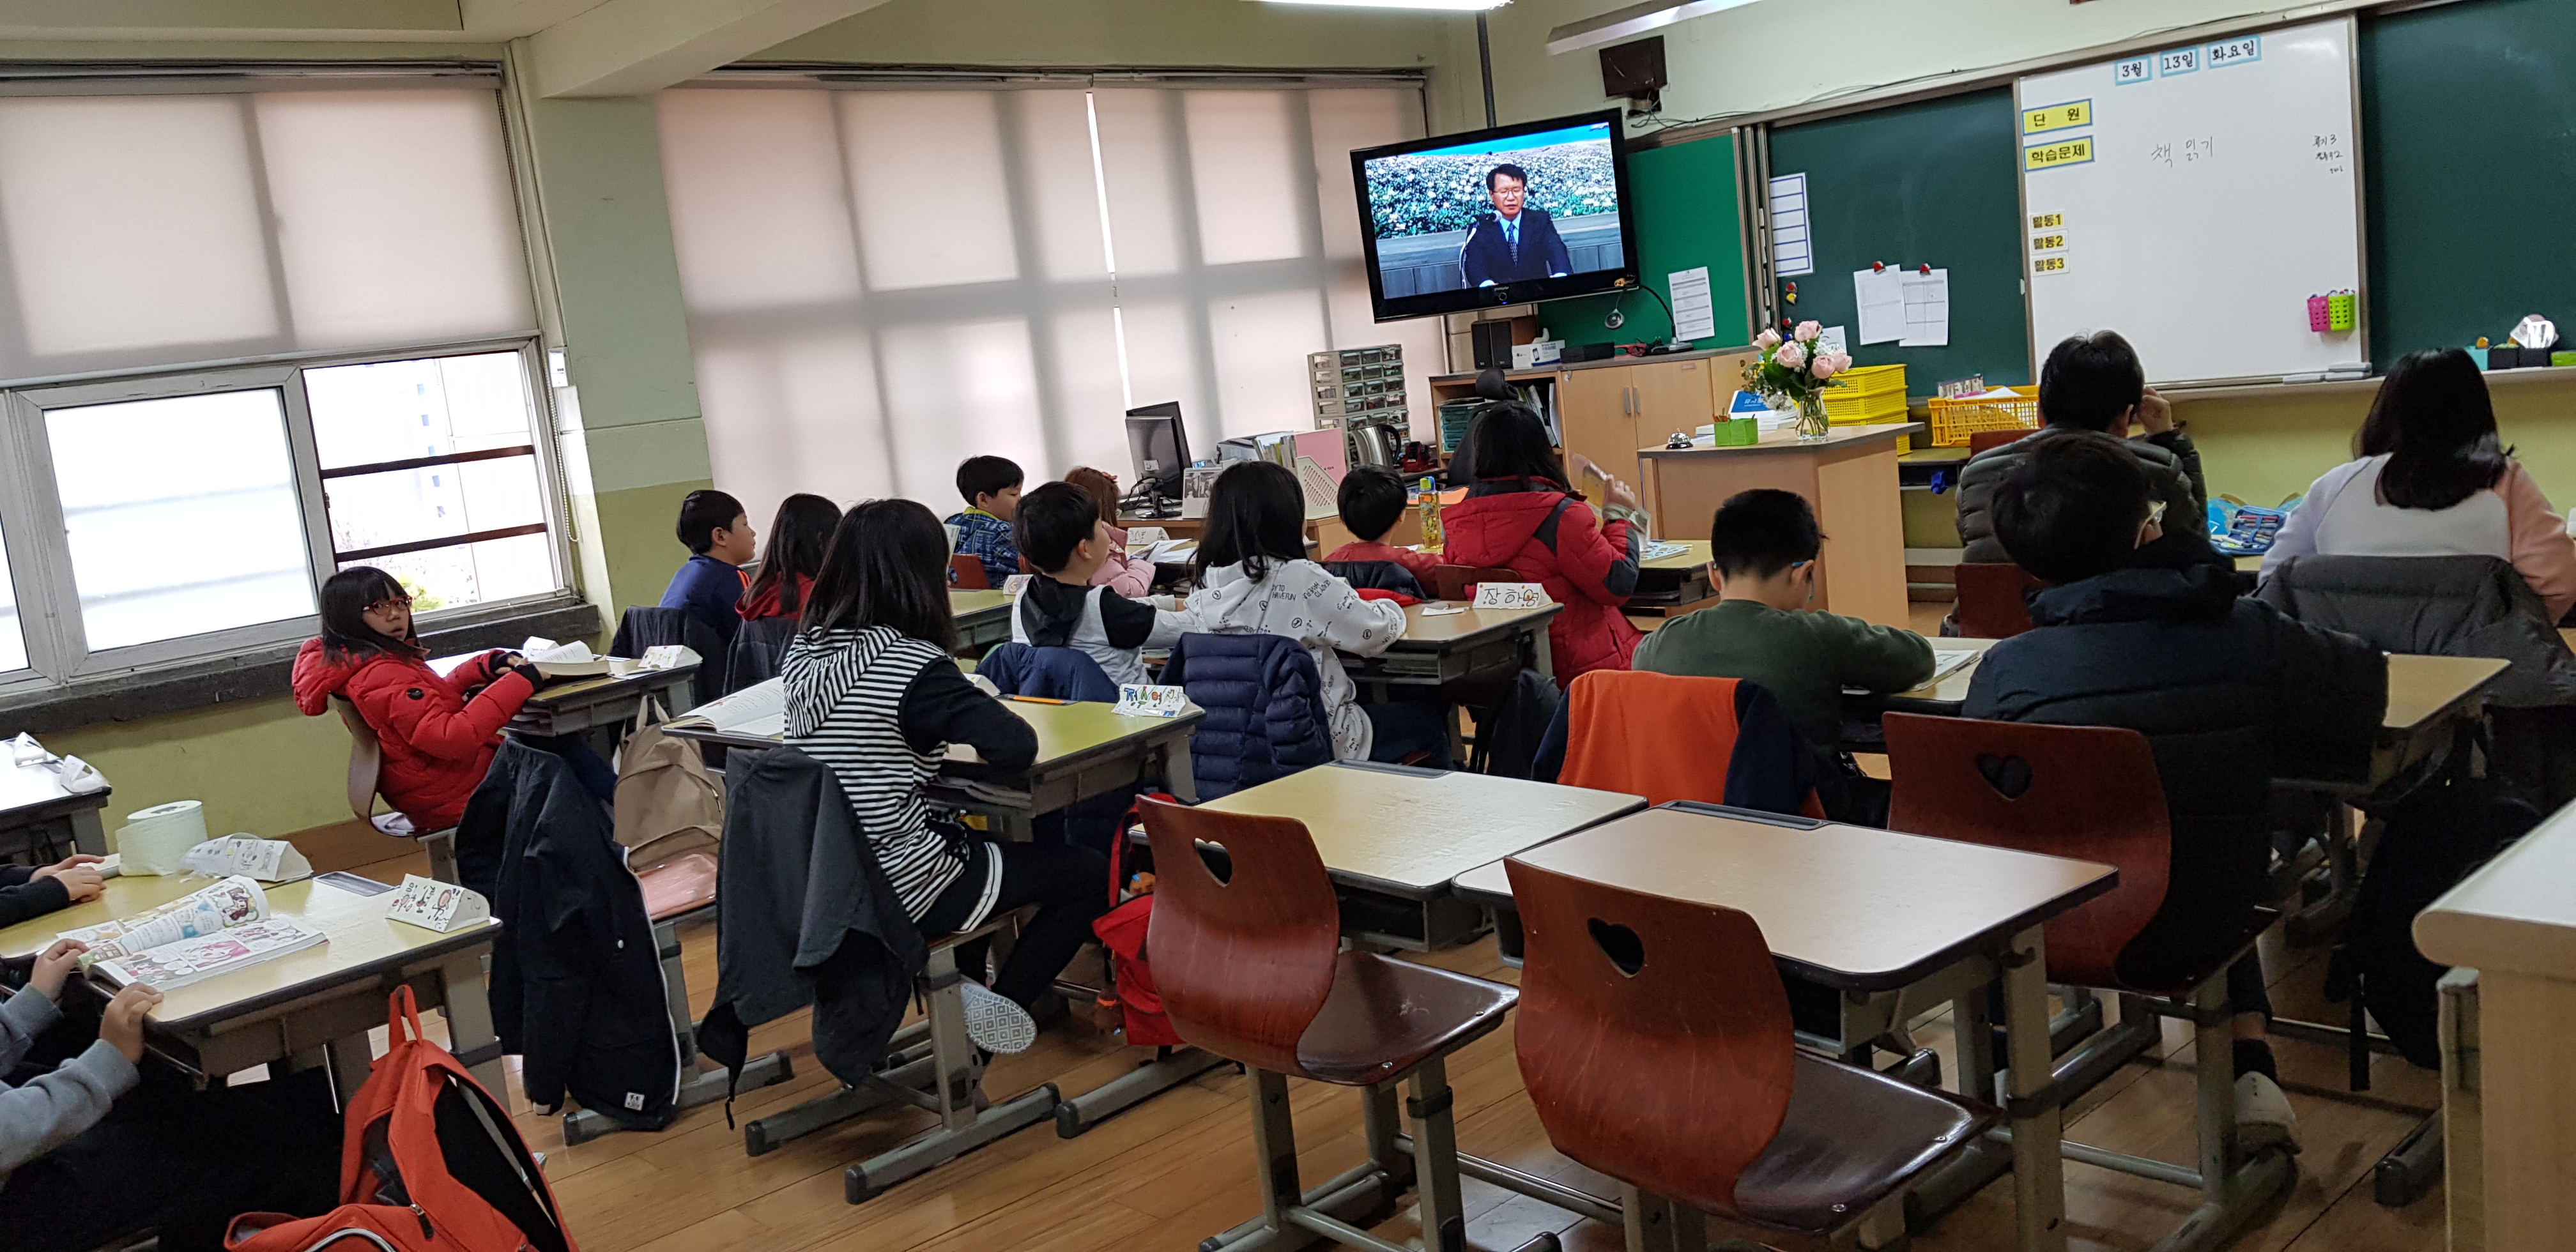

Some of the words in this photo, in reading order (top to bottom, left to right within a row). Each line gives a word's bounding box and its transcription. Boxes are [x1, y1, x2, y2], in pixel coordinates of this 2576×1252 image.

[2122, 62, 2142, 77] 3월
[2165, 52, 2193, 70] 13일
[2212, 40, 2255, 61] 화요일
[2032, 143, 2085, 163] 학습문제
[2151, 142, 2173, 167] 책
[2186, 135, 2212, 161] 읽기
[2032, 213, 2061, 228] 활동1
[2034, 235, 2064, 250] 활동2
[2035, 257, 2064, 272] 활동3
